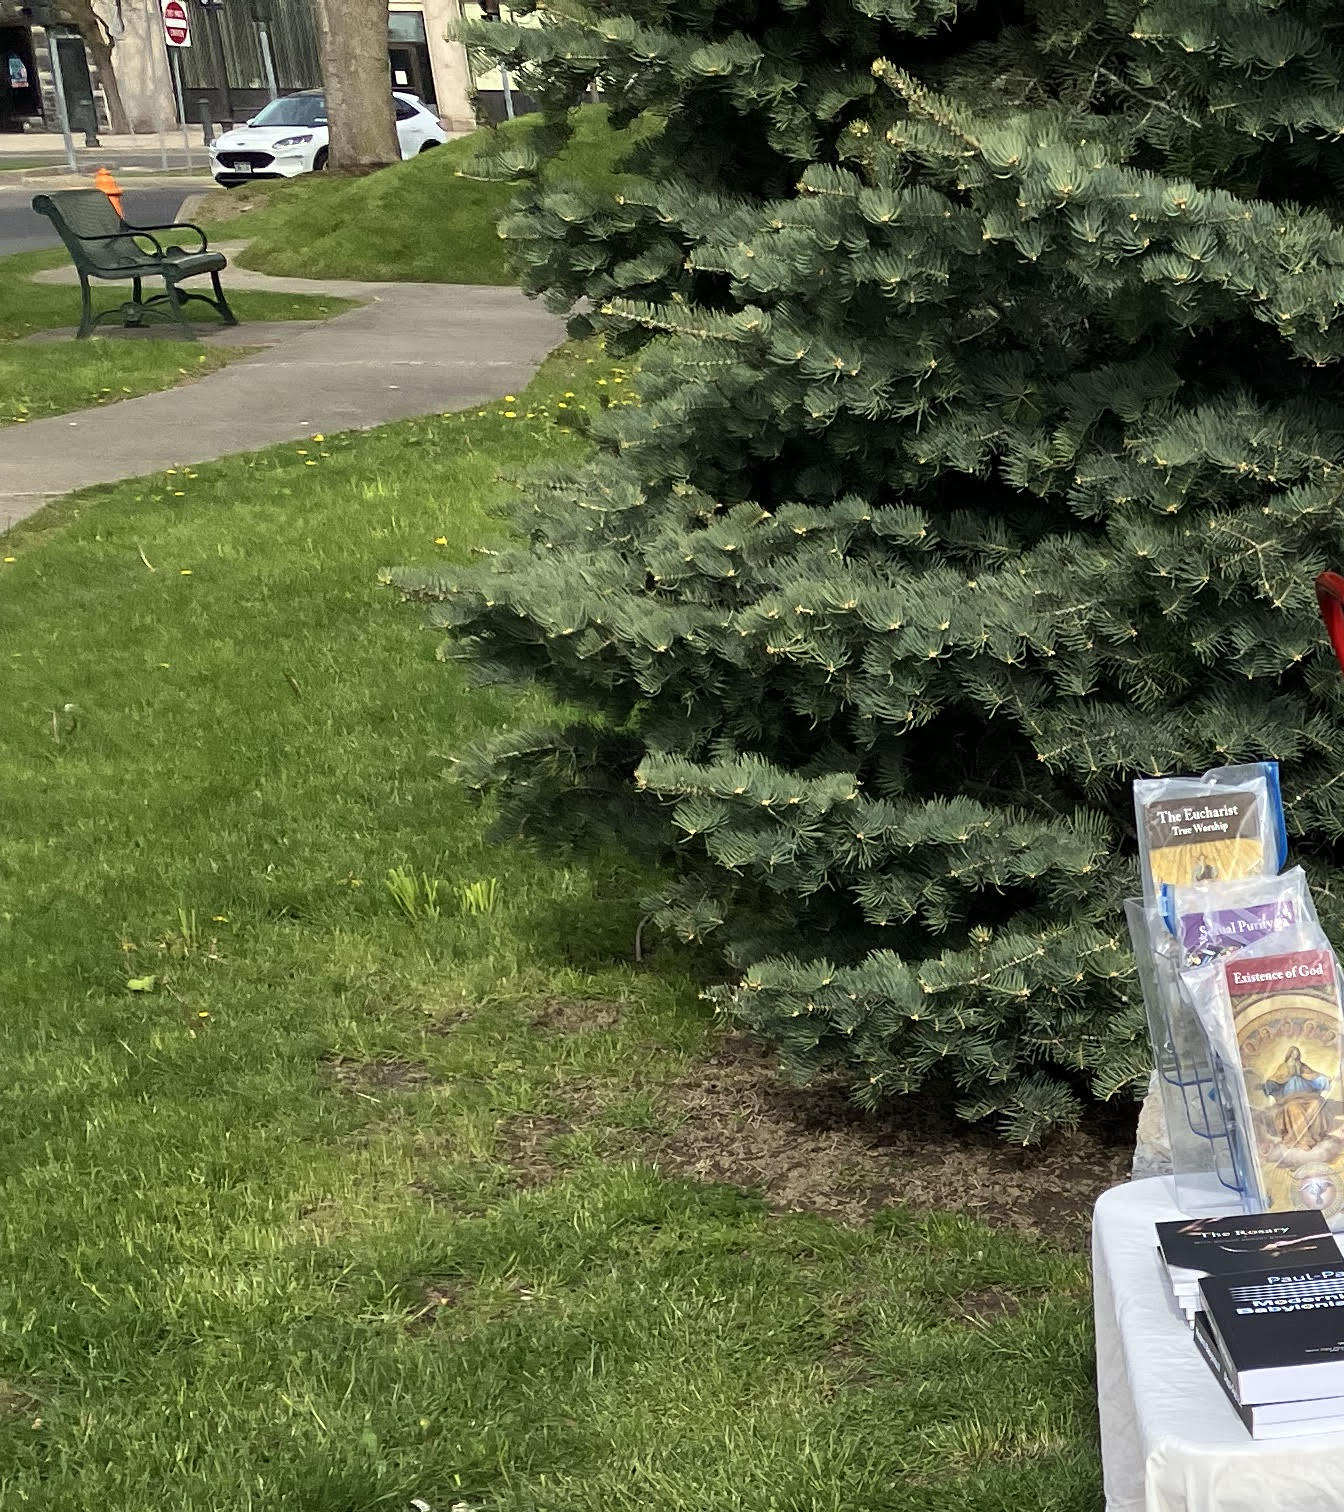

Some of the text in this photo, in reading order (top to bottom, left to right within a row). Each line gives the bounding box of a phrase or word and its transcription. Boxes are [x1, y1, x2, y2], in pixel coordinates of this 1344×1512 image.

[1157, 804, 1239, 824] The Eucharist
[1171, 822, 1228, 836] True Worship
[1238, 913, 1274, 934] Purity
[1232, 963, 1324, 986] Existence of God
[1234, 1226, 1290, 1239] Rosary
